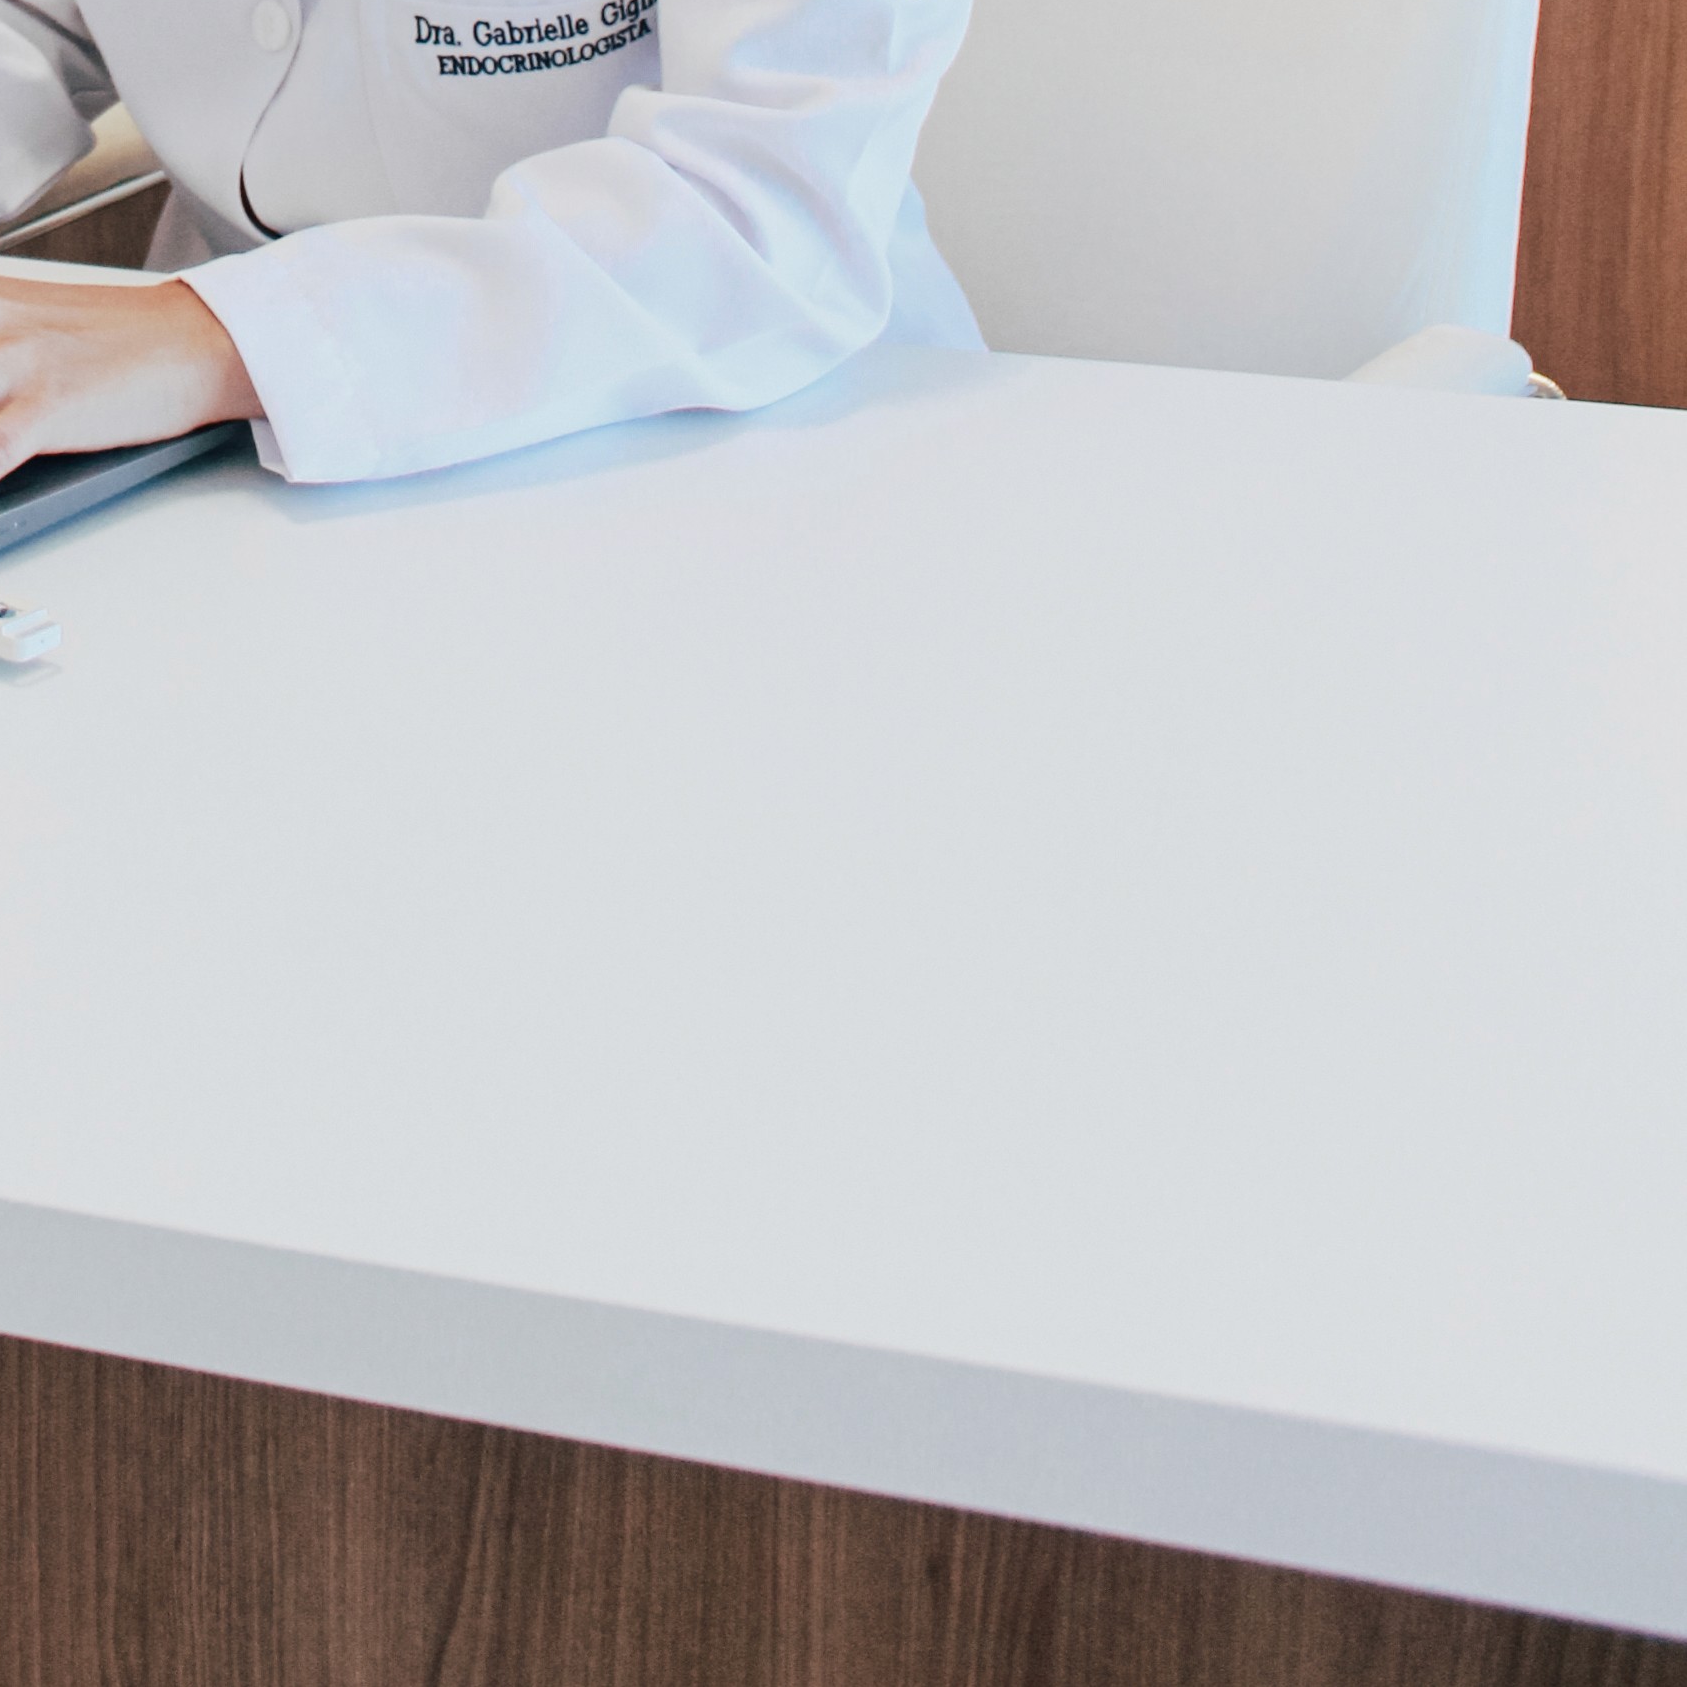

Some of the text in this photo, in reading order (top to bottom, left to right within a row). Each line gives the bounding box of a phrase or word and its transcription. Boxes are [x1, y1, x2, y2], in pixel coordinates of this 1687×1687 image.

[414, 15, 461, 46] Dra.
[473, 14, 588, 47] Gabrielle
[437, 19, 651, 76] ENDOCRINOLOGISTA
